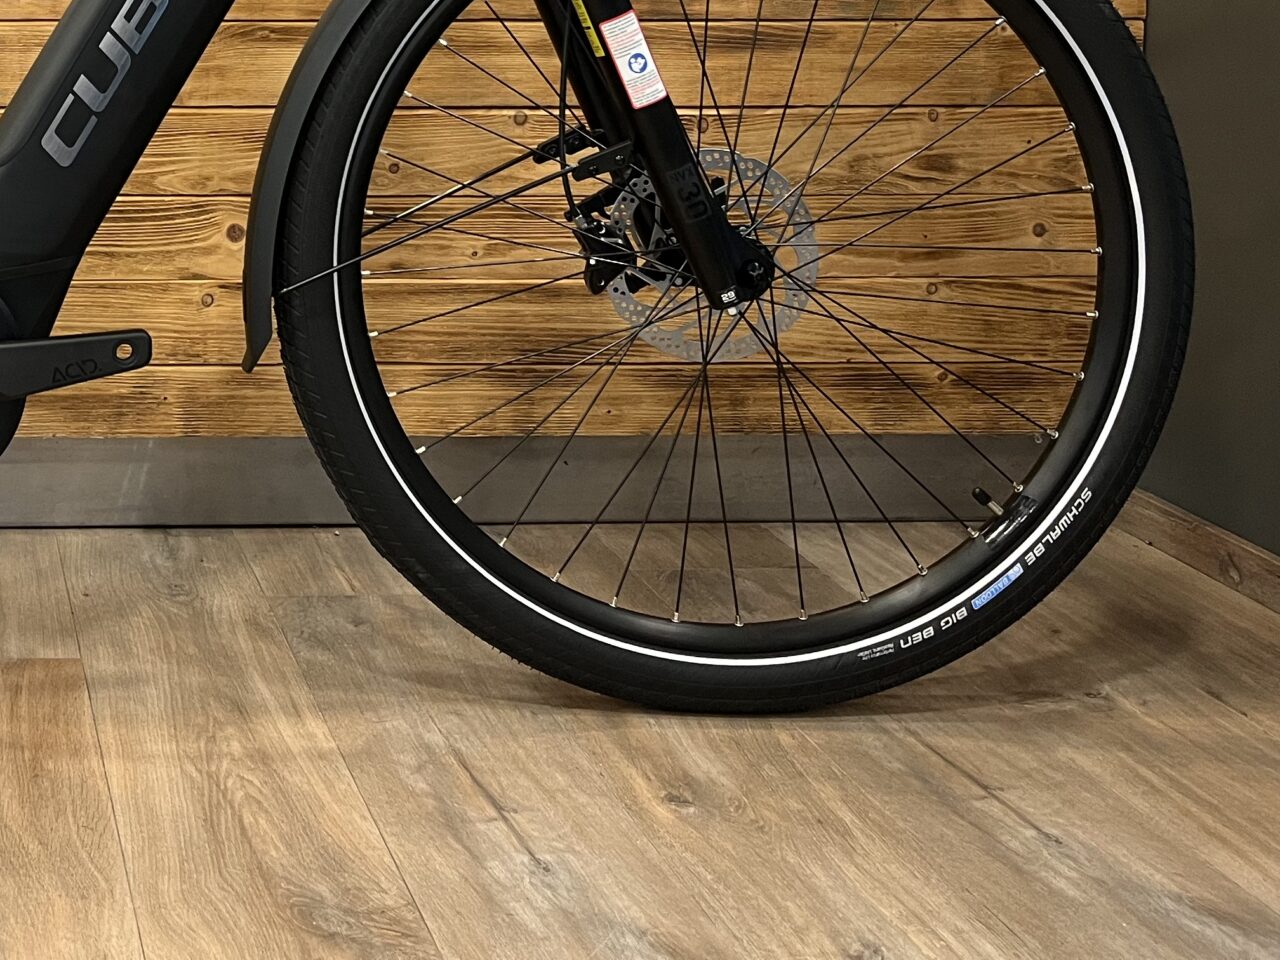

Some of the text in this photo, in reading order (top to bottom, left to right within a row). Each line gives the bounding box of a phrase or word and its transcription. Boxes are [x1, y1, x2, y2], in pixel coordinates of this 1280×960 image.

[720, 291, 736, 301] 29
[1024, 486, 1093, 567] SCHWALBE
[940, 606, 968, 631] BIG
[899, 625, 935, 649] BEN
